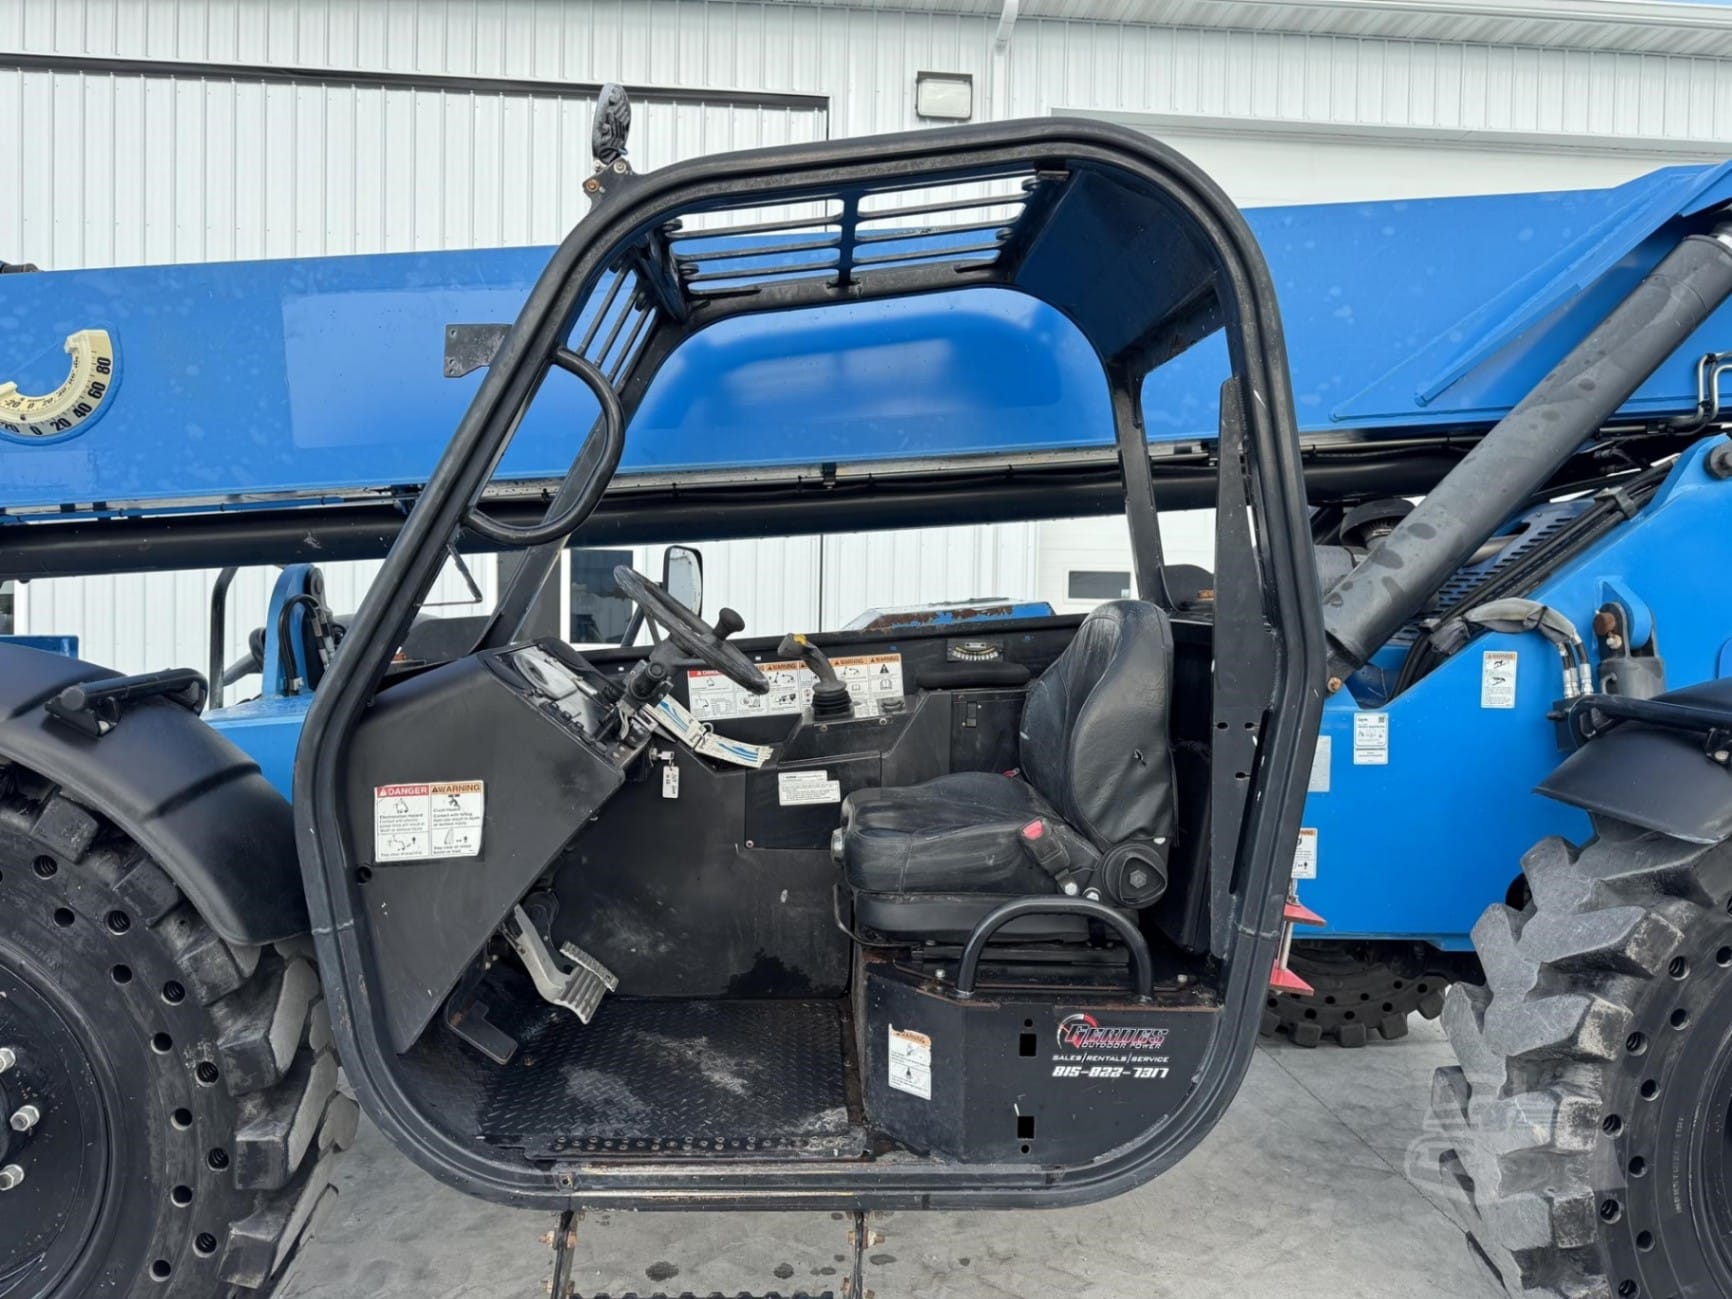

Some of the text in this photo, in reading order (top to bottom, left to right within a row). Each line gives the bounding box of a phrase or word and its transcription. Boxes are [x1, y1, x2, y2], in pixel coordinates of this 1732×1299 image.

[96, 357, 111, 375] 80
[88, 381, 106, 399] 60
[73, 402, 92, 418] 40
[29, 425, 43, 435] 0
[50, 418, 72, 431] 20
[387, 786, 428, 796] DANGER
[438, 783, 481, 793] WARNING
